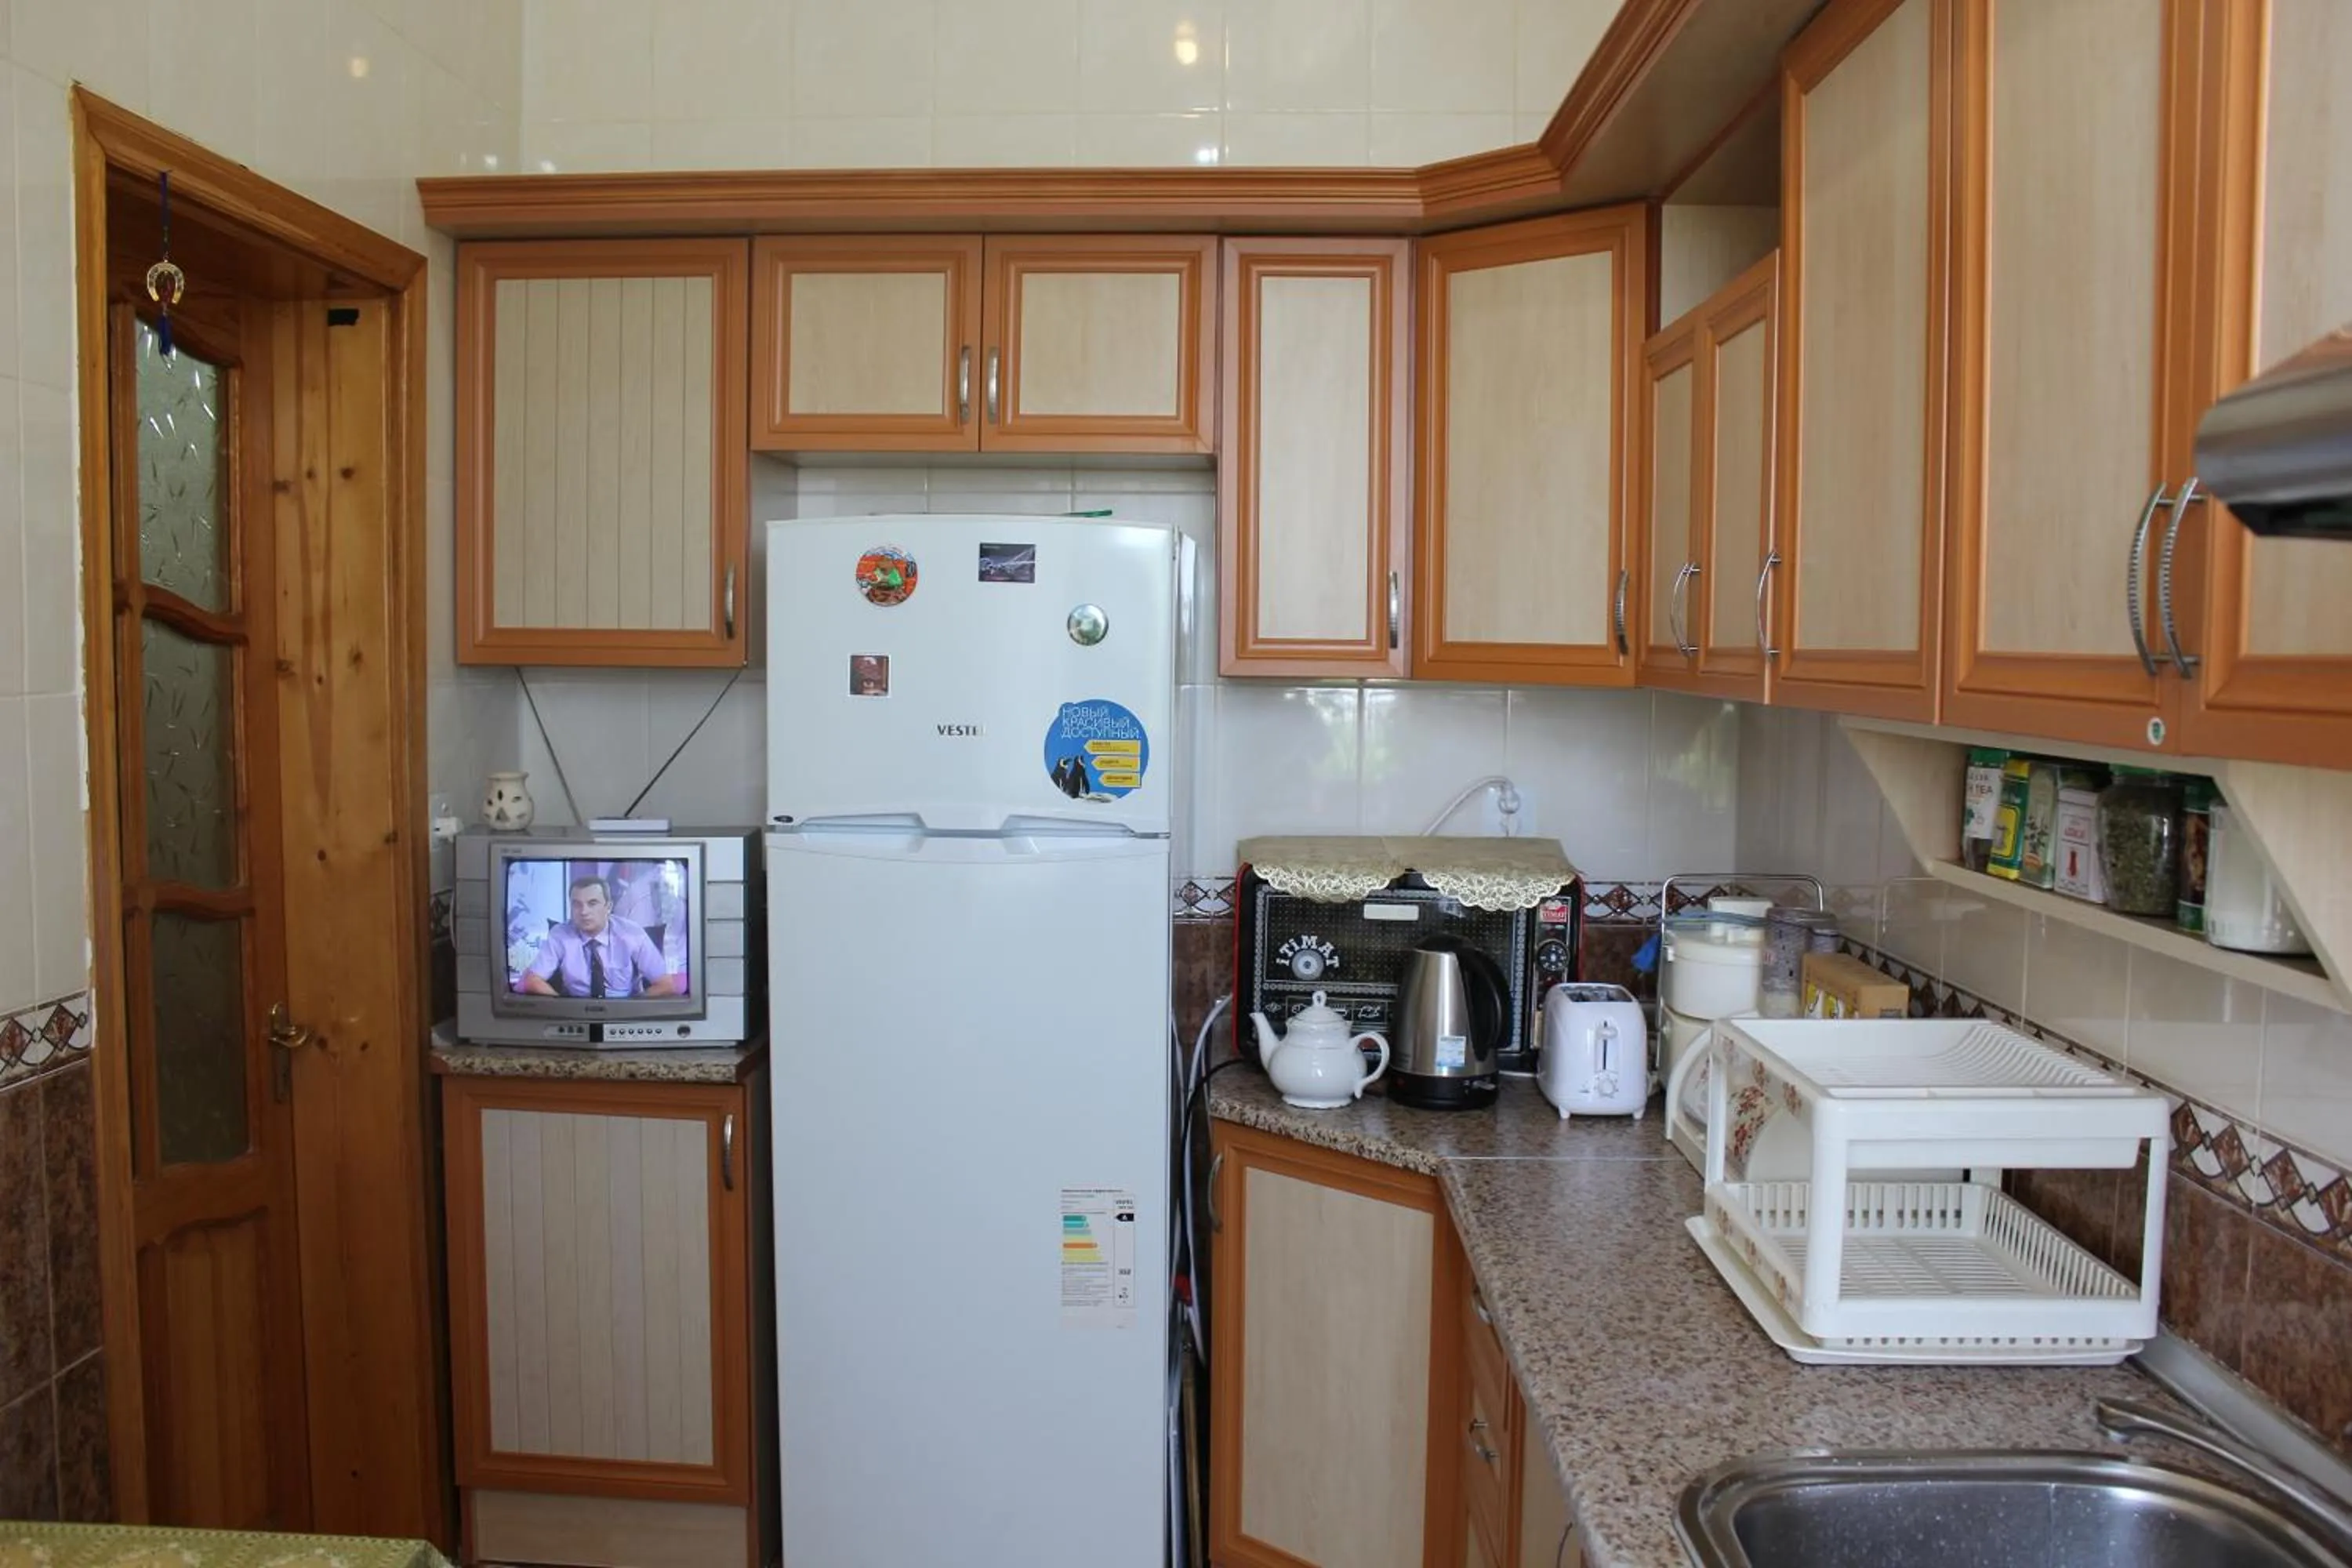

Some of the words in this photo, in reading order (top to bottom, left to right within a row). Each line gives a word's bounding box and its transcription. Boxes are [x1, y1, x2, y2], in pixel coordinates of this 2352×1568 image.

[1062, 706, 1109, 718] НОВЫЙ
[1062, 716, 1130, 729] КРАСИВЫЙ
[937, 724, 985, 736] VEST
